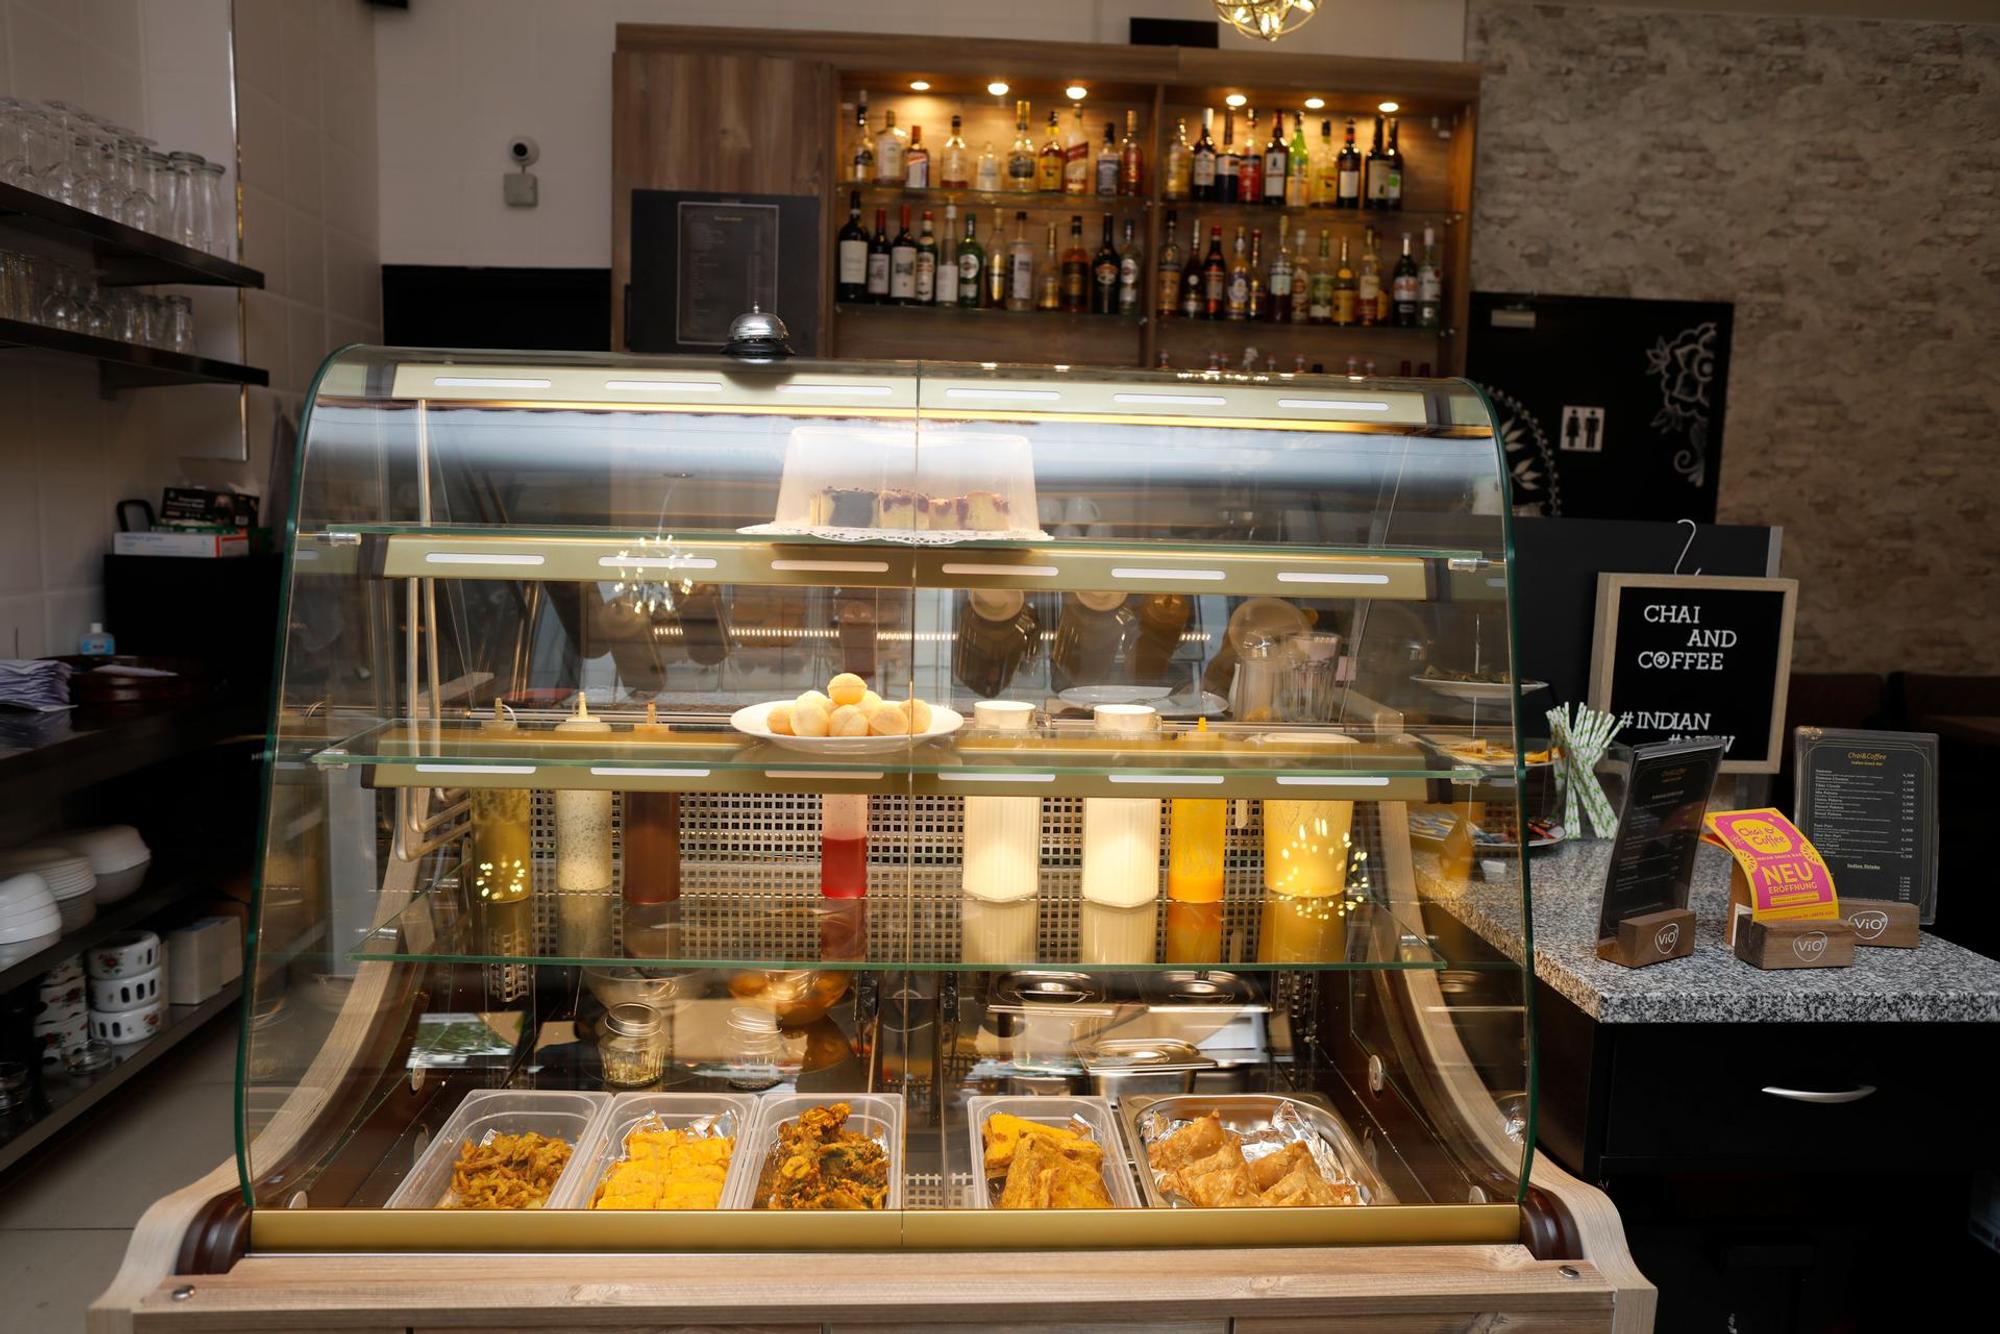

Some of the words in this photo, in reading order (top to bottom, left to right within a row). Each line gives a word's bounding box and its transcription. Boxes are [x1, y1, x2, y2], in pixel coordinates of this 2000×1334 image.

[1643, 605, 1700, 624] CHAI
[1686, 629, 1737, 648] AND
[1638, 651, 1724, 670] COFFEE
[1752, 834, 1784, 848] Coffee
[1761, 862, 1814, 885] NEU
